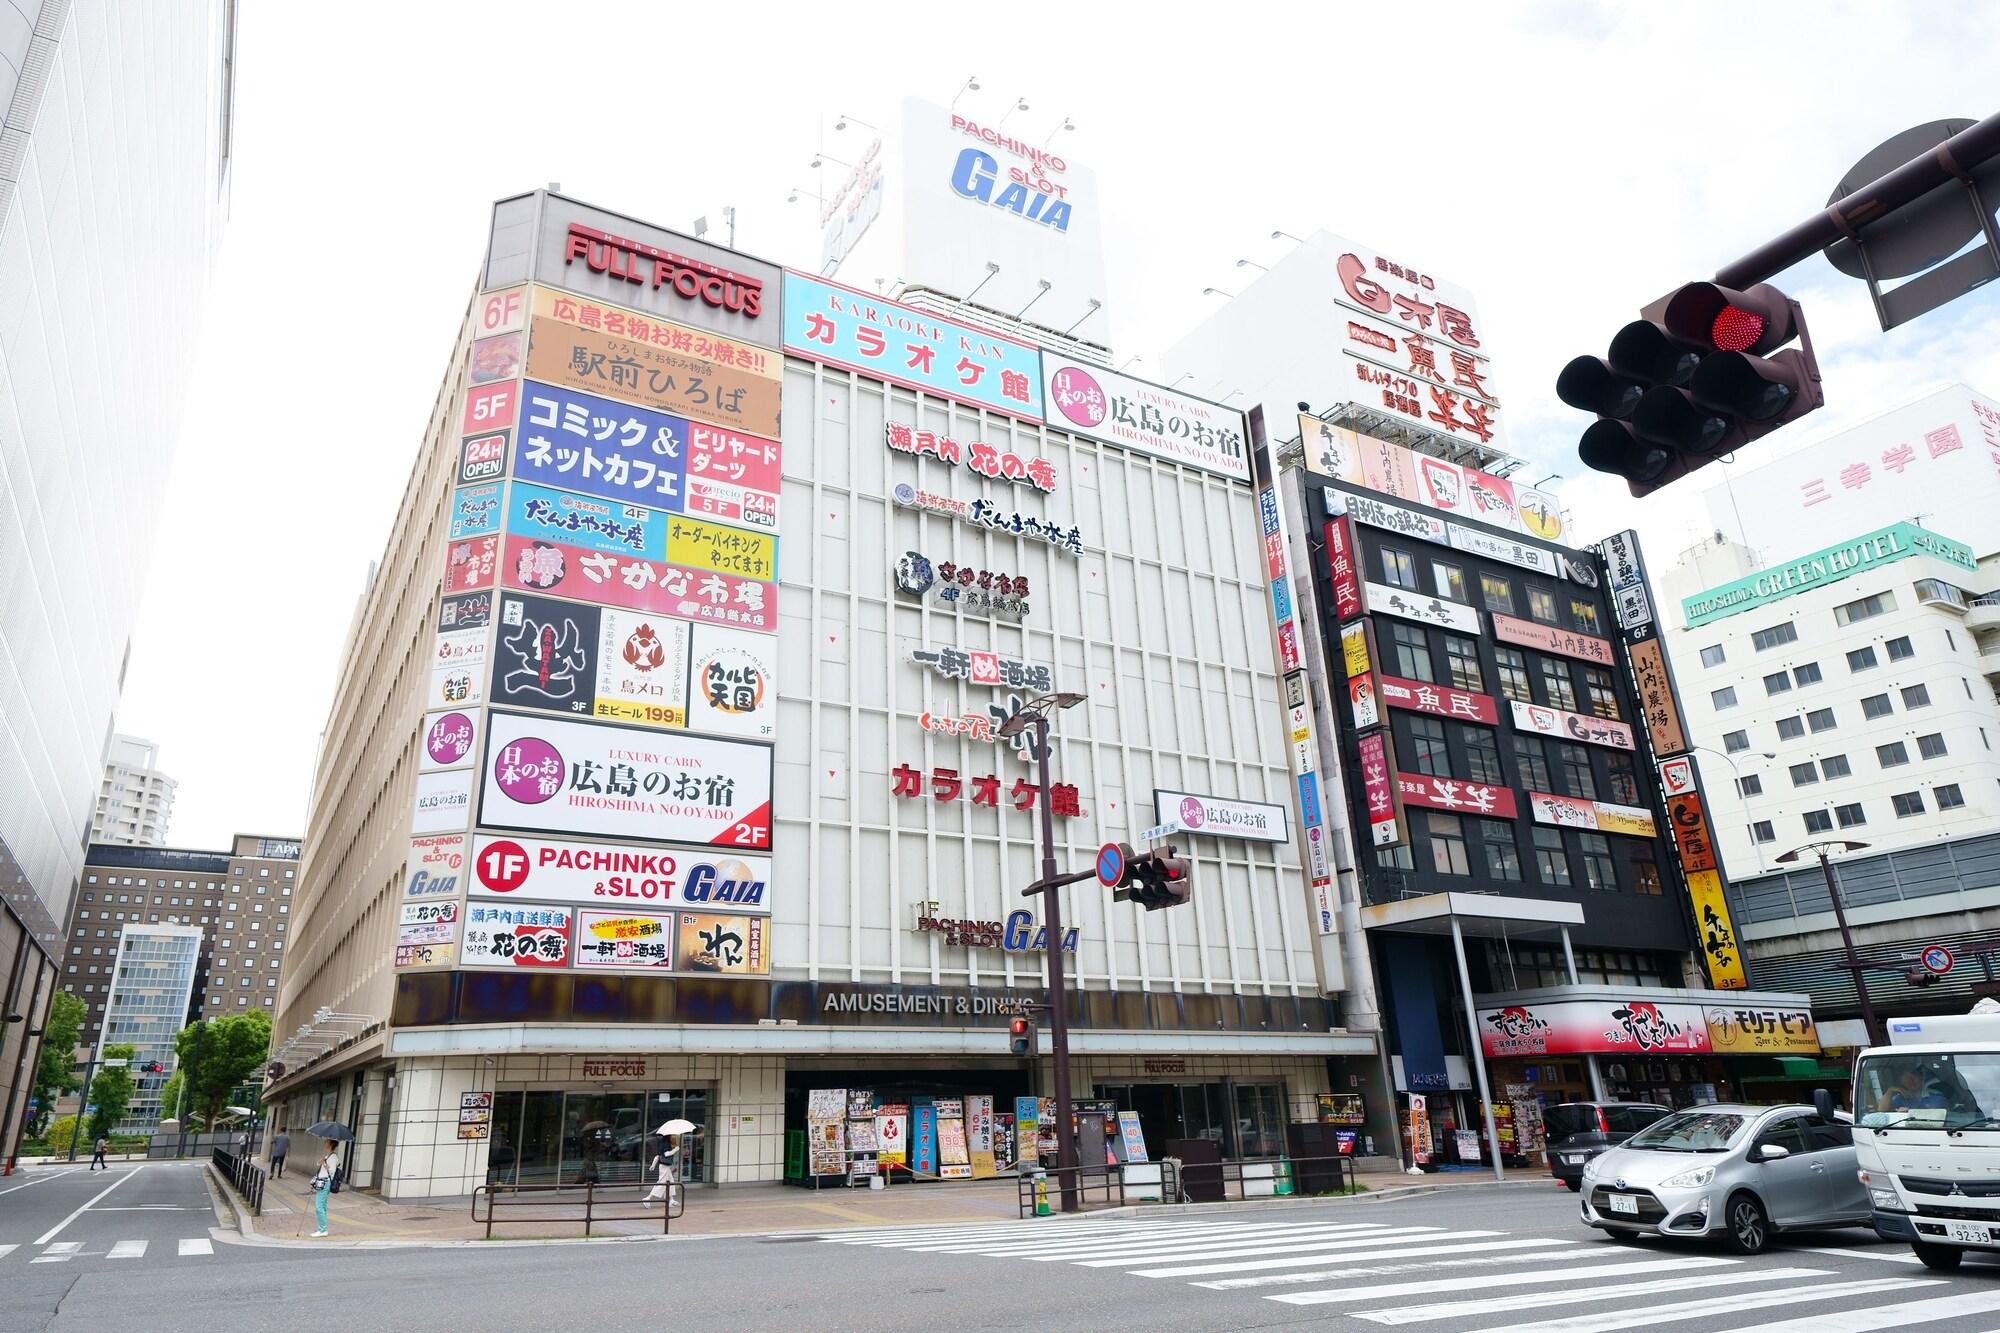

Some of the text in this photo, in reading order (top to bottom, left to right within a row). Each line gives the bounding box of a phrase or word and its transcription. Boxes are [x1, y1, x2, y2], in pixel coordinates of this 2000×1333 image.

[951, 114, 1067, 172] PACHINKO
[1008, 167, 1067, 200] SLOT
[1031, 162, 1047, 178] &
[950, 147, 1073, 233] GAIA
[604, 232, 736, 280] HIROSHIMA
[566, 234, 763, 319] FULL FOCUS
[483, 291, 523, 330] 6F
[1336, 253, 1481, 349] 白木屋
[552, 297, 767, 375] 広島名物お好み焼き!!
[828, 293, 1004, 360] KARAOKE KAN
[607, 340, 713, 377] ひろしま お好み物語
[804, 312, 1031, 404] カラオケ館
[1401, 332, 1494, 401] 魚民
[567, 344, 748, 415] 駅前ひろば
[1356, 362, 1418, 398] 新しいタイプの
[472, 392, 508, 421] 5F
[1136, 389, 1211, 420] LUXURY CABIN
[529, 394, 680, 458] コミック &
[1110, 394, 1241, 460] 広島のお宿
[468, 439, 501, 458] 24H
[691, 427, 778, 466] ビリヤード
[887, 421, 1057, 493] 瀬戸内 花の舞
[1111, 423, 1244, 472] HIROSHIMA NO OYADO
[466, 458, 502, 477] OPEN
[524, 435, 679, 497] ネットカフェ
[690, 454, 748, 480] ダーツ
[1800, 422, 1964, 508] 三幸学園
[625, 507, 647, 520] 4F
[745, 493, 775, 513] 24H
[1345, 496, 1430, 536] 目利きの銀次
[525, 499, 646, 550] だんまや水産
[744, 511, 775, 526] OPEN
[970, 498, 1085, 555] だんまや水産
[671, 522, 762, 555] オーダーバイキング
[710, 549, 770, 577] やってます!
[1512, 545, 1540, 566] 黒田
[578, 550, 765, 613] さかな市場
[937, 560, 1030, 599] さかな市場
[1331, 555, 1358, 606] 魚民
[1687, 530, 1909, 619] HIROSHIMA GREEN HOTEL
[940, 587, 961, 601] 4F
[1624, 596, 1640, 620] 黒田
[1343, 605, 1354, 615] 2F
[1494, 615, 1505, 624] 5F
[1550, 630, 1604, 660] 山内農場
[1633, 625, 1648, 639] 6F
[709, 662, 760, 685] カルビ
[912, 647, 1051, 693] 一軒め酒場
[1355, 666, 1365, 675] 1F
[620, 679, 664, 697] 鳥メロ
[710, 682, 756, 712] 天国
[1413, 685, 1484, 721] 魚民
[1638, 656, 1669, 728] 山内農場
[571, 700, 587, 711] 3F
[597, 703, 644, 720] 生ビール
[1361, 716, 1372, 725] 1F
[431, 722, 470, 756] 日本のお宿
[760, 725, 773, 734] 3F
[1567, 715, 1629, 747] 白木屋
[609, 749, 702, 768] LUXURY CABIN
[1663, 741, 1678, 753] 5F
[500, 745, 560, 796] 日本のお宿
[569, 759, 736, 807] 広島のお宿
[892, 763, 1080, 817] カラオケ館
[568, 794, 735, 821] HIROSHIMA NO OYADO
[1206, 807, 1267, 829] 広島のお宿
[412, 835, 463, 848] PACHINKO
[734, 823, 767, 844] 2F
[1674, 803, 1707, 856] 白木屋
[422, 853, 449, 863] SLOT
[485, 850, 524, 880] 1F
[539, 846, 676, 876] PACHINKO
[1691, 859, 1708, 869] 4F
[408, 870, 458, 896] GAIA
[593, 875, 676, 900] &SLOT
[681, 861, 767, 906] GAIA
[471, 908, 566, 927] 瀬戸内直送鮮魚
[683, 916, 697, 924] B1F
[917, 916, 1003, 936] PACHINKO
[490, 932, 566, 960] 花の舞
[581, 940, 666, 959] 一軒め酒場
[698, 923, 743, 967] わん
[959, 933, 1002, 949] SLOT
[1721, 978, 1738, 989] 3F
[823, 992, 953, 1014] AMUSEMENT
[955, 996, 969, 1013] &
[1754, 1036, 1771, 1047] Beer
[1784, 1036, 1817, 1047] Restaurant
[583, 1064, 646, 1077] FULL FOCUS
[920, 1108, 930, 1171] カラオケ館
[1955, 1230, 1990, 1243] 92-39
